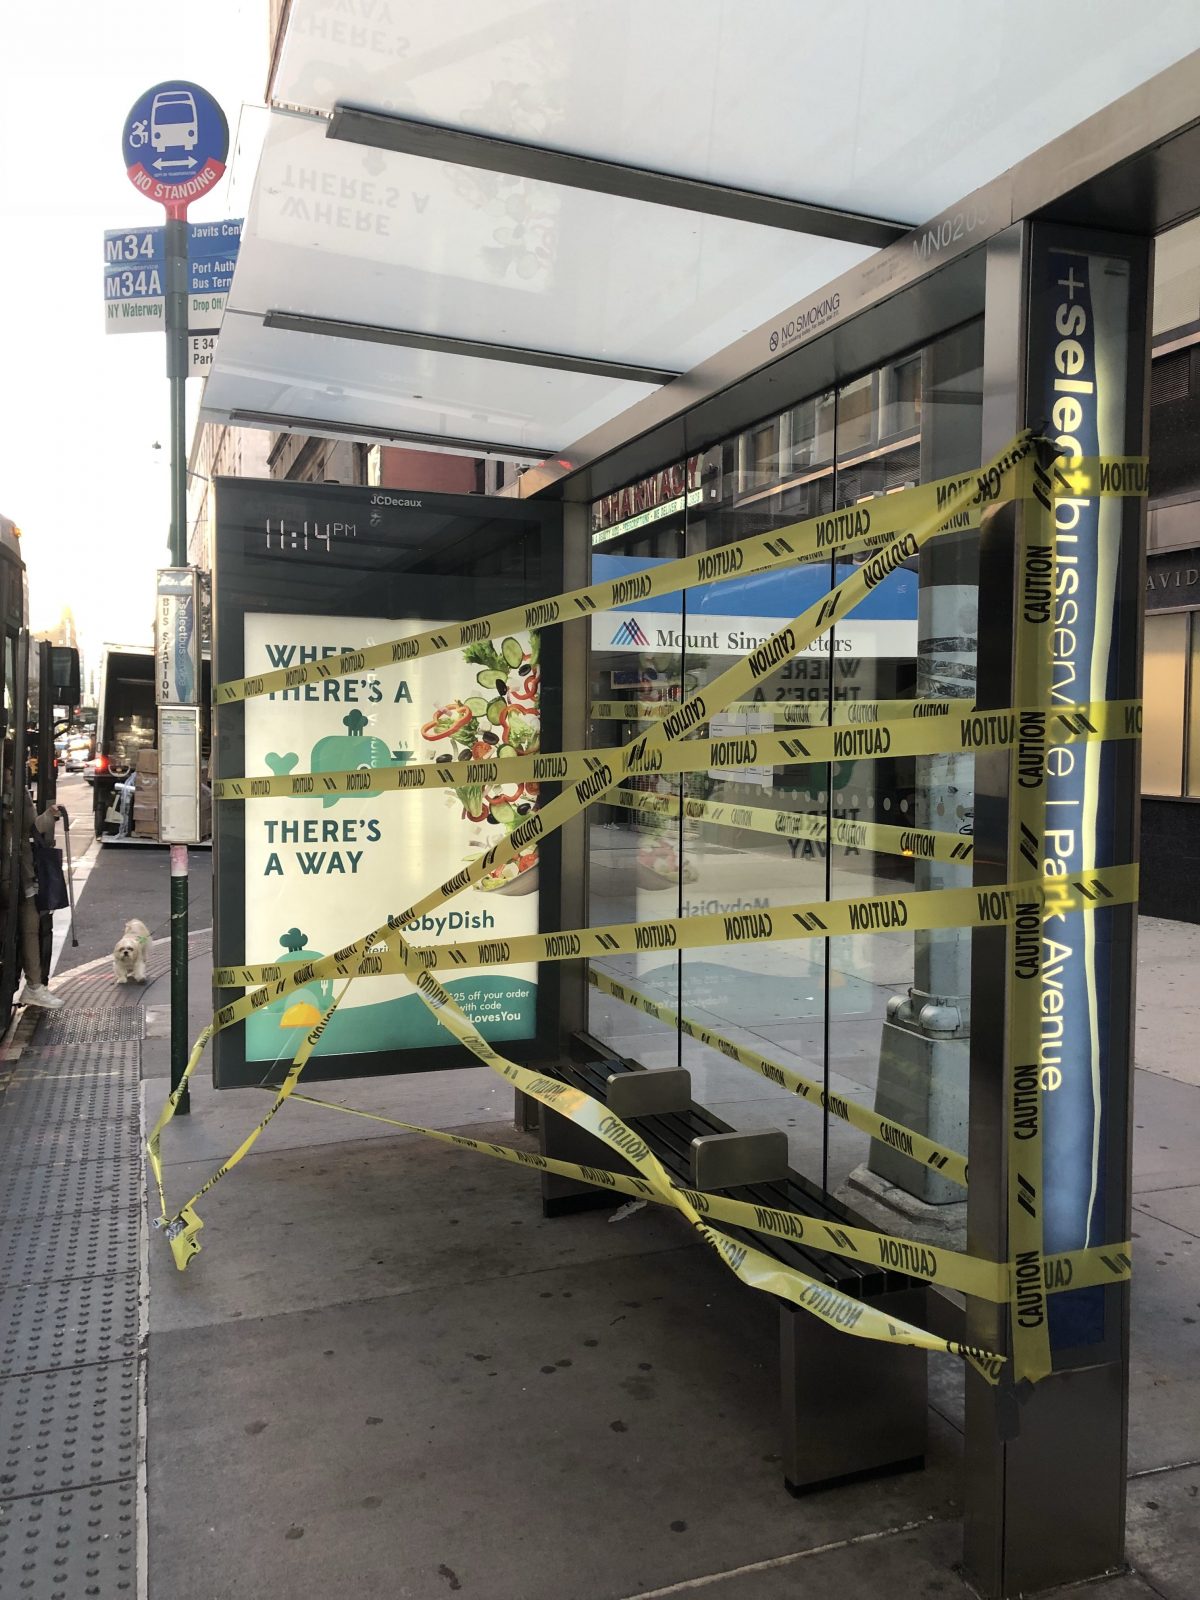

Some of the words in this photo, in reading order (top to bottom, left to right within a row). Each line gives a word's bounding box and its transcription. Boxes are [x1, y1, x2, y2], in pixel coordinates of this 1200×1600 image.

[134, 171, 152, 191] NO
[154, 168, 216, 199] STANDING
[107, 234, 154, 260] M34
[192, 227, 218, 238] Javits
[192, 262, 211, 274] Port
[214, 261, 235, 272] Auth
[107, 270, 161, 297] M34A
[192, 278, 209, 289] Bus
[108, 304, 119, 318] NY
[122, 303, 163, 319] Waterway
[193, 299, 209, 312] Drop
[781, 321, 795, 341] NO
[796, 293, 840, 332] SMOKING
[193, 339, 199, 350] E
[202, 338, 214, 350] 34
[370, 495, 422, 507] JCDecaux
[600, 456, 699, 524] PHARMACY
[266, 519, 330, 552] 11:14
[333, 523, 357, 537] PM
[863, 533, 920, 589] CAUTION
[1024, 545, 1053, 623] CAUTION
[656, 629, 719, 649] Mount
[728, 631, 774, 650] Sina
[800, 637, 852, 652] ctors
[748, 628, 796, 678] CAUTION
[265, 644, 375, 671] WHE
[394, 681, 413, 703] A
[662, 697, 706, 741] CAUTION
[848, 704, 878, 723] CAUTION
[913, 703, 949, 718] CAUTION
[1018, 712, 1046, 788] CAUTION
[575, 764, 612, 804] CAUTION
[264, 818, 382, 844] THERE'S
[510, 815, 543, 850] CAUTION
[837, 823, 867, 846] CAUTION
[900, 832, 935, 858] CAUTION
[263, 853, 284, 876] A
[296, 850, 364, 875] WAY
[1043, 829, 1076, 922] Park
[441, 867, 471, 896] CAUTION
[1015, 903, 1040, 980] CAUTION
[449, 992, 465, 1002] 25
[468, 990, 481, 1001] off
[483, 991, 503, 1002] your
[506, 989, 529, 999] order
[479, 1001, 502, 1010] code
[1038, 938, 1072, 1091] Avenue
[760, 1061, 785, 1086] CAUTION
[880, 1122, 913, 1156] CAUTION
[1014, 1064, 1038, 1140] CAUTION
[1015, 1251, 1044, 1328] CAUTION
